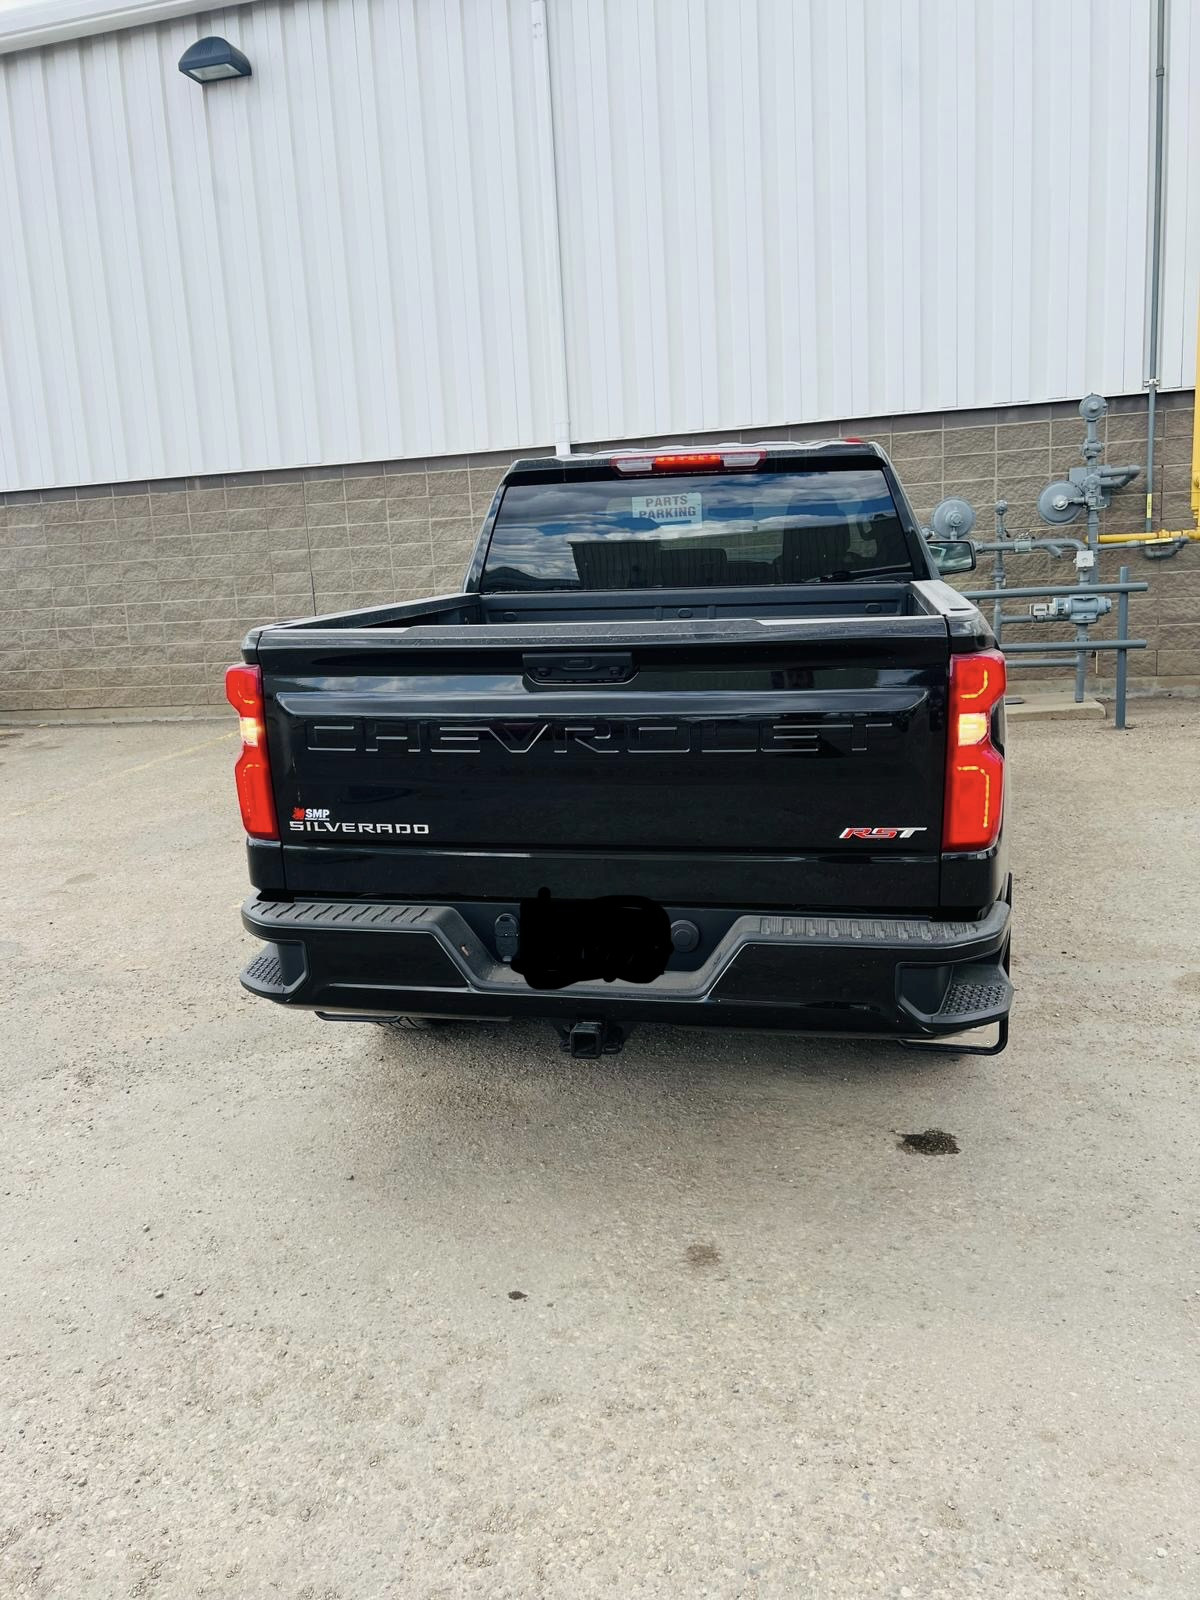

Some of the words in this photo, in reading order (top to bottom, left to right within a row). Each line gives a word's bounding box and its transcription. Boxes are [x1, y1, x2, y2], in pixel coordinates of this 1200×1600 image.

[645, 495, 688, 507] PARTS
[638, 506, 697, 519] PARKING
[305, 721, 893, 754] CHEVROLET
[305, 808, 330, 818] SMP
[289, 820, 430, 834] SILVERADO
[839, 827, 928, 838] RST
